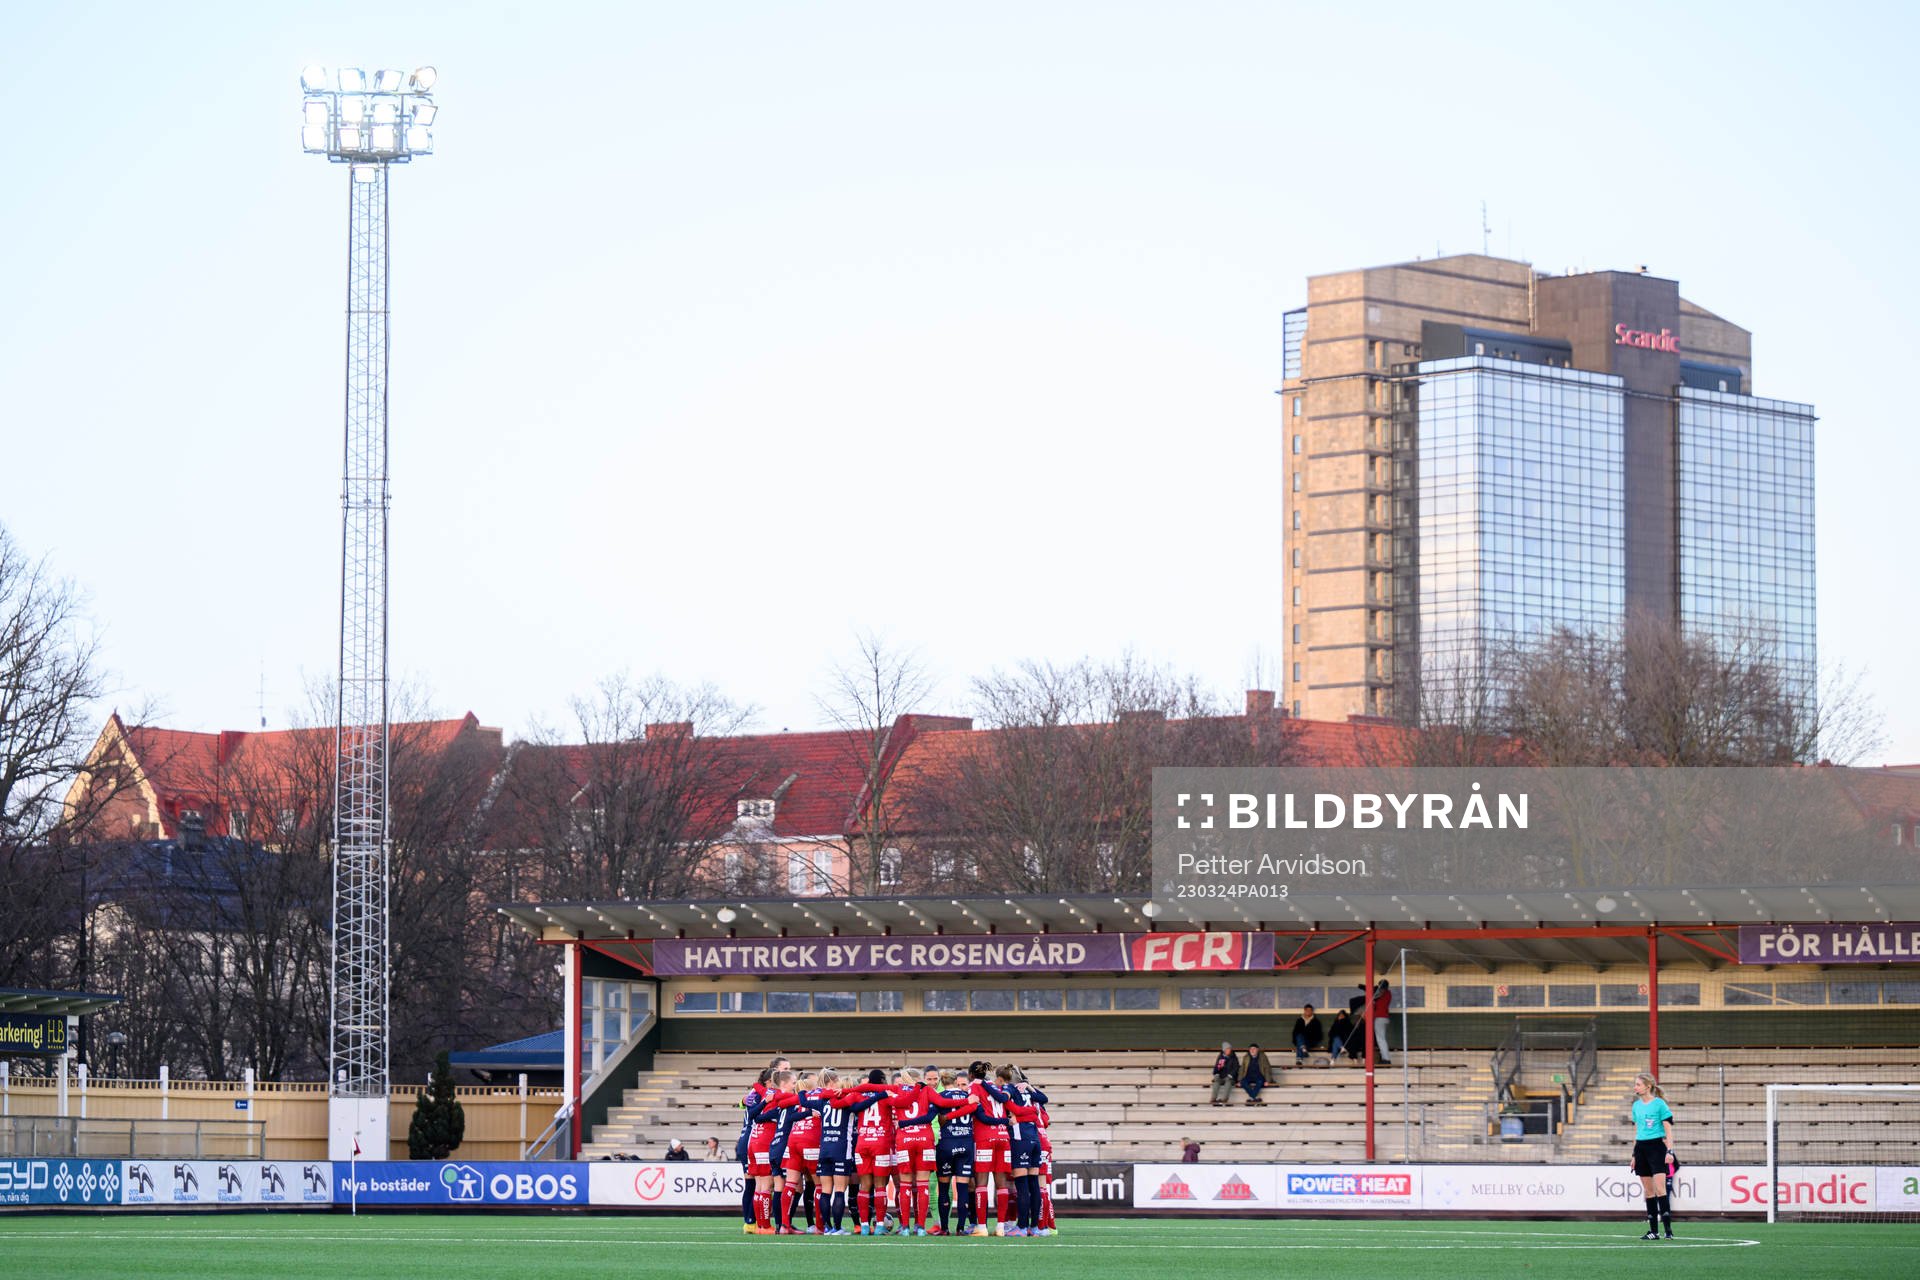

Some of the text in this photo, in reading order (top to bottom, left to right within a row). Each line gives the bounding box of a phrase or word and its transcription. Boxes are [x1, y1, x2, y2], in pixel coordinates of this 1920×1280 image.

[1615, 322, 1680, 353] Scandic
[684, 936, 1086, 969] HATTRICK BY FC ROSENGÅRD
[1143, 932, 1233, 971] FCR
[1759, 927, 1821, 957] FÖR
[341, 1177, 431, 1196] Nya bostäder
[490, 1173, 577, 1200] OBOS
[673, 1171, 744, 1193] SPRÅKS
[1047, 1173, 1125, 1200] dium
[1291, 1177, 1406, 1192] POWER HEAT
[1471, 1181, 1565, 1196] MELLBY GÅRD
[1730, 1174, 1867, 1204] Scandic
